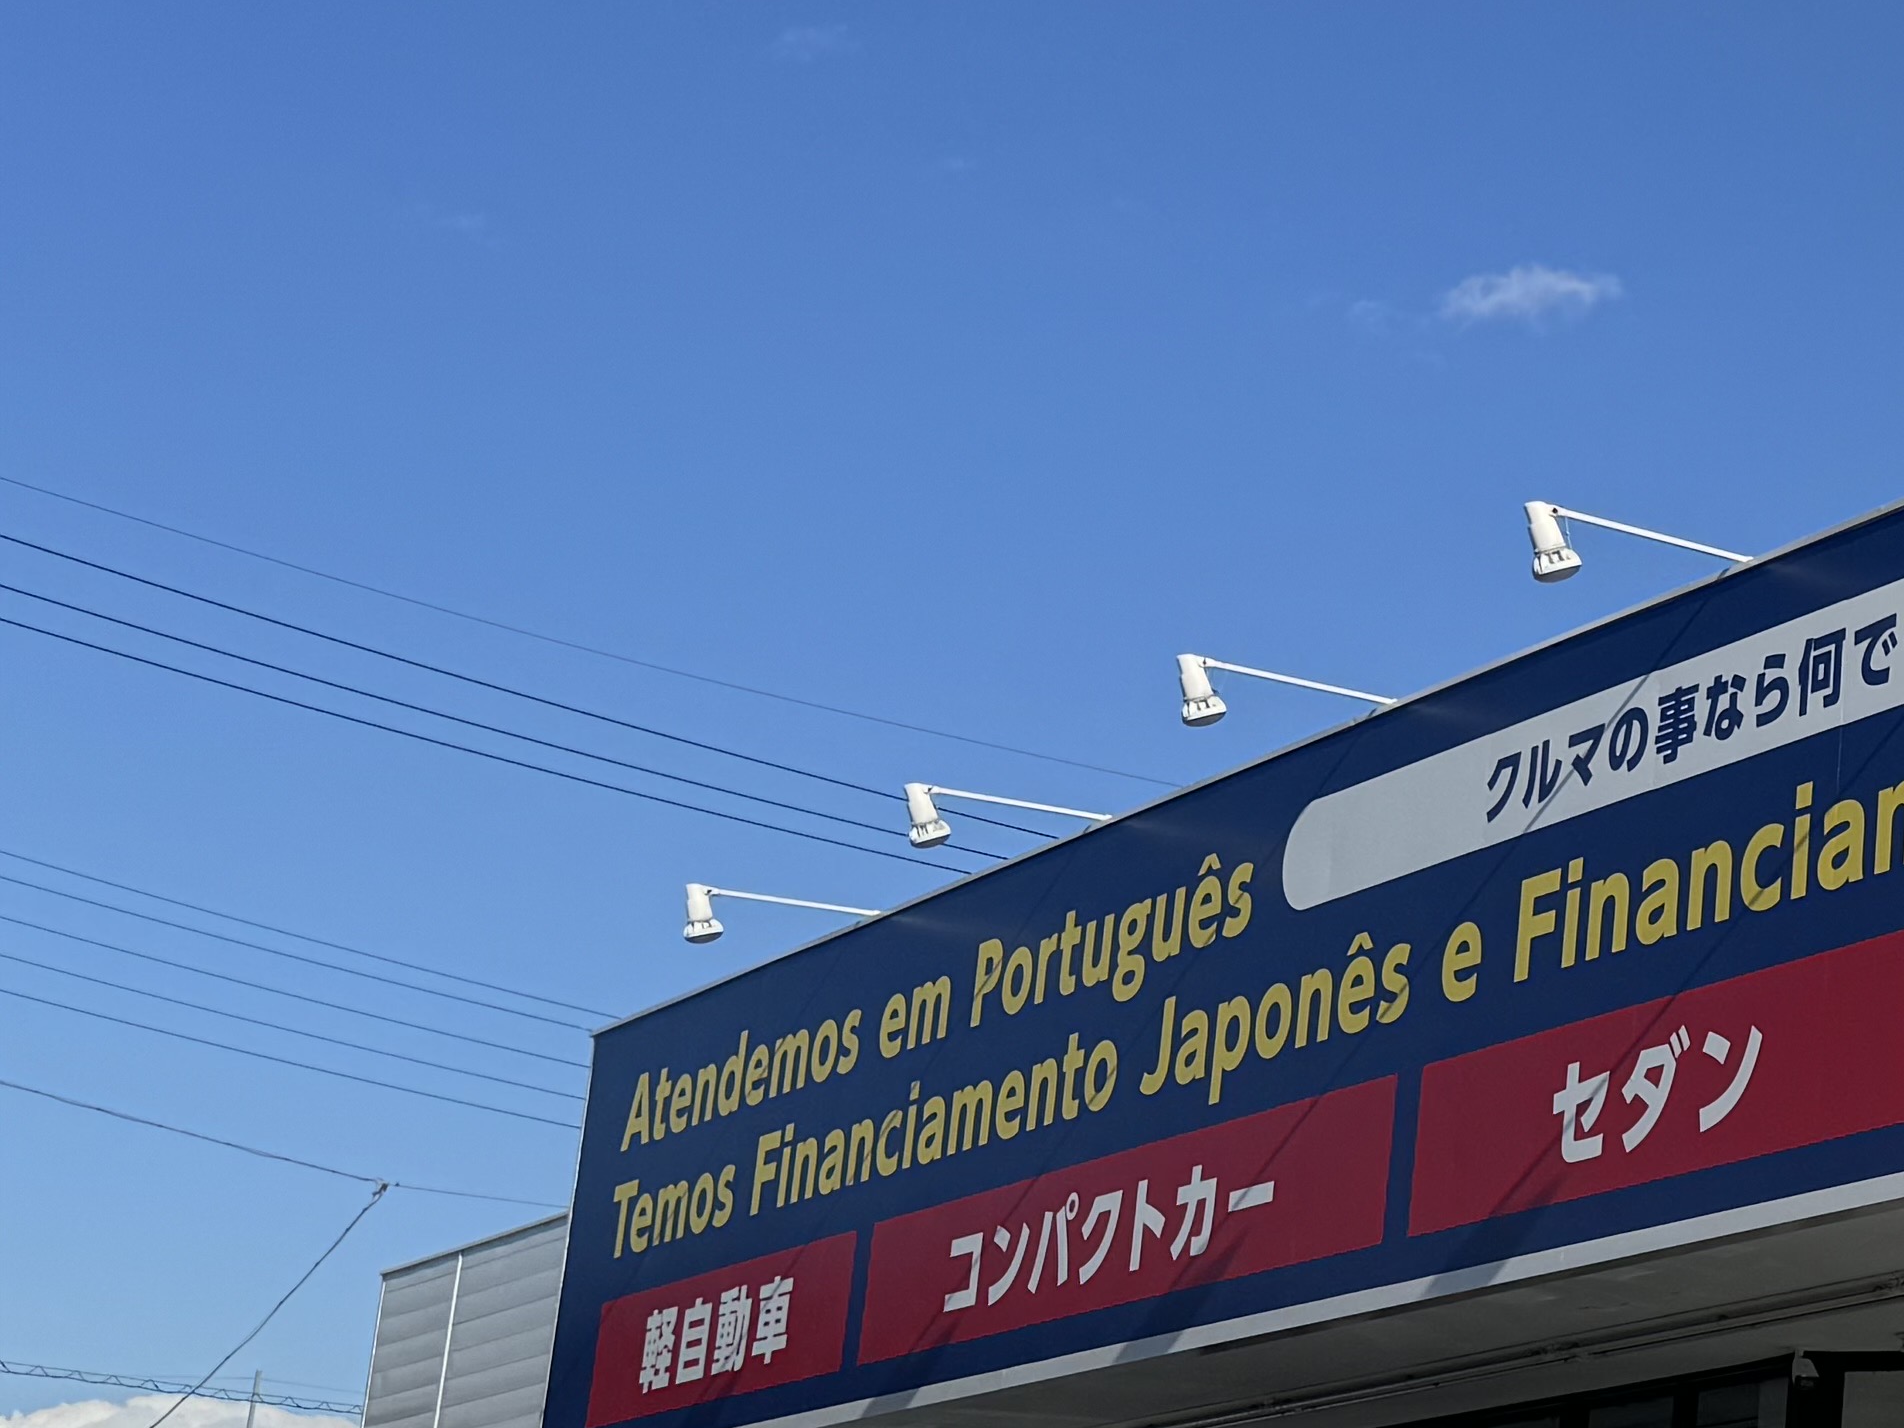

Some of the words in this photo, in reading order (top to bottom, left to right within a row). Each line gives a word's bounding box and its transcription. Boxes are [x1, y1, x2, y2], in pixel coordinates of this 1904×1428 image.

[619, 1028, 862, 1152] Atendemos
[878, 976, 951, 1059] em
[969, 851, 1254, 1028] Português
[612, 1163, 735, 1259] Temos
[750, 1031, 1118, 1217] Financiamento
[1138, 931, 1412, 1105] Japonês
[1440, 915, 1485, 1006] e
[1553, 1022, 1765, 1166] セダン
[943, 1163, 1276, 1314] コンパクトカー
[637, 1275, 795, 1394] 軽自動車
